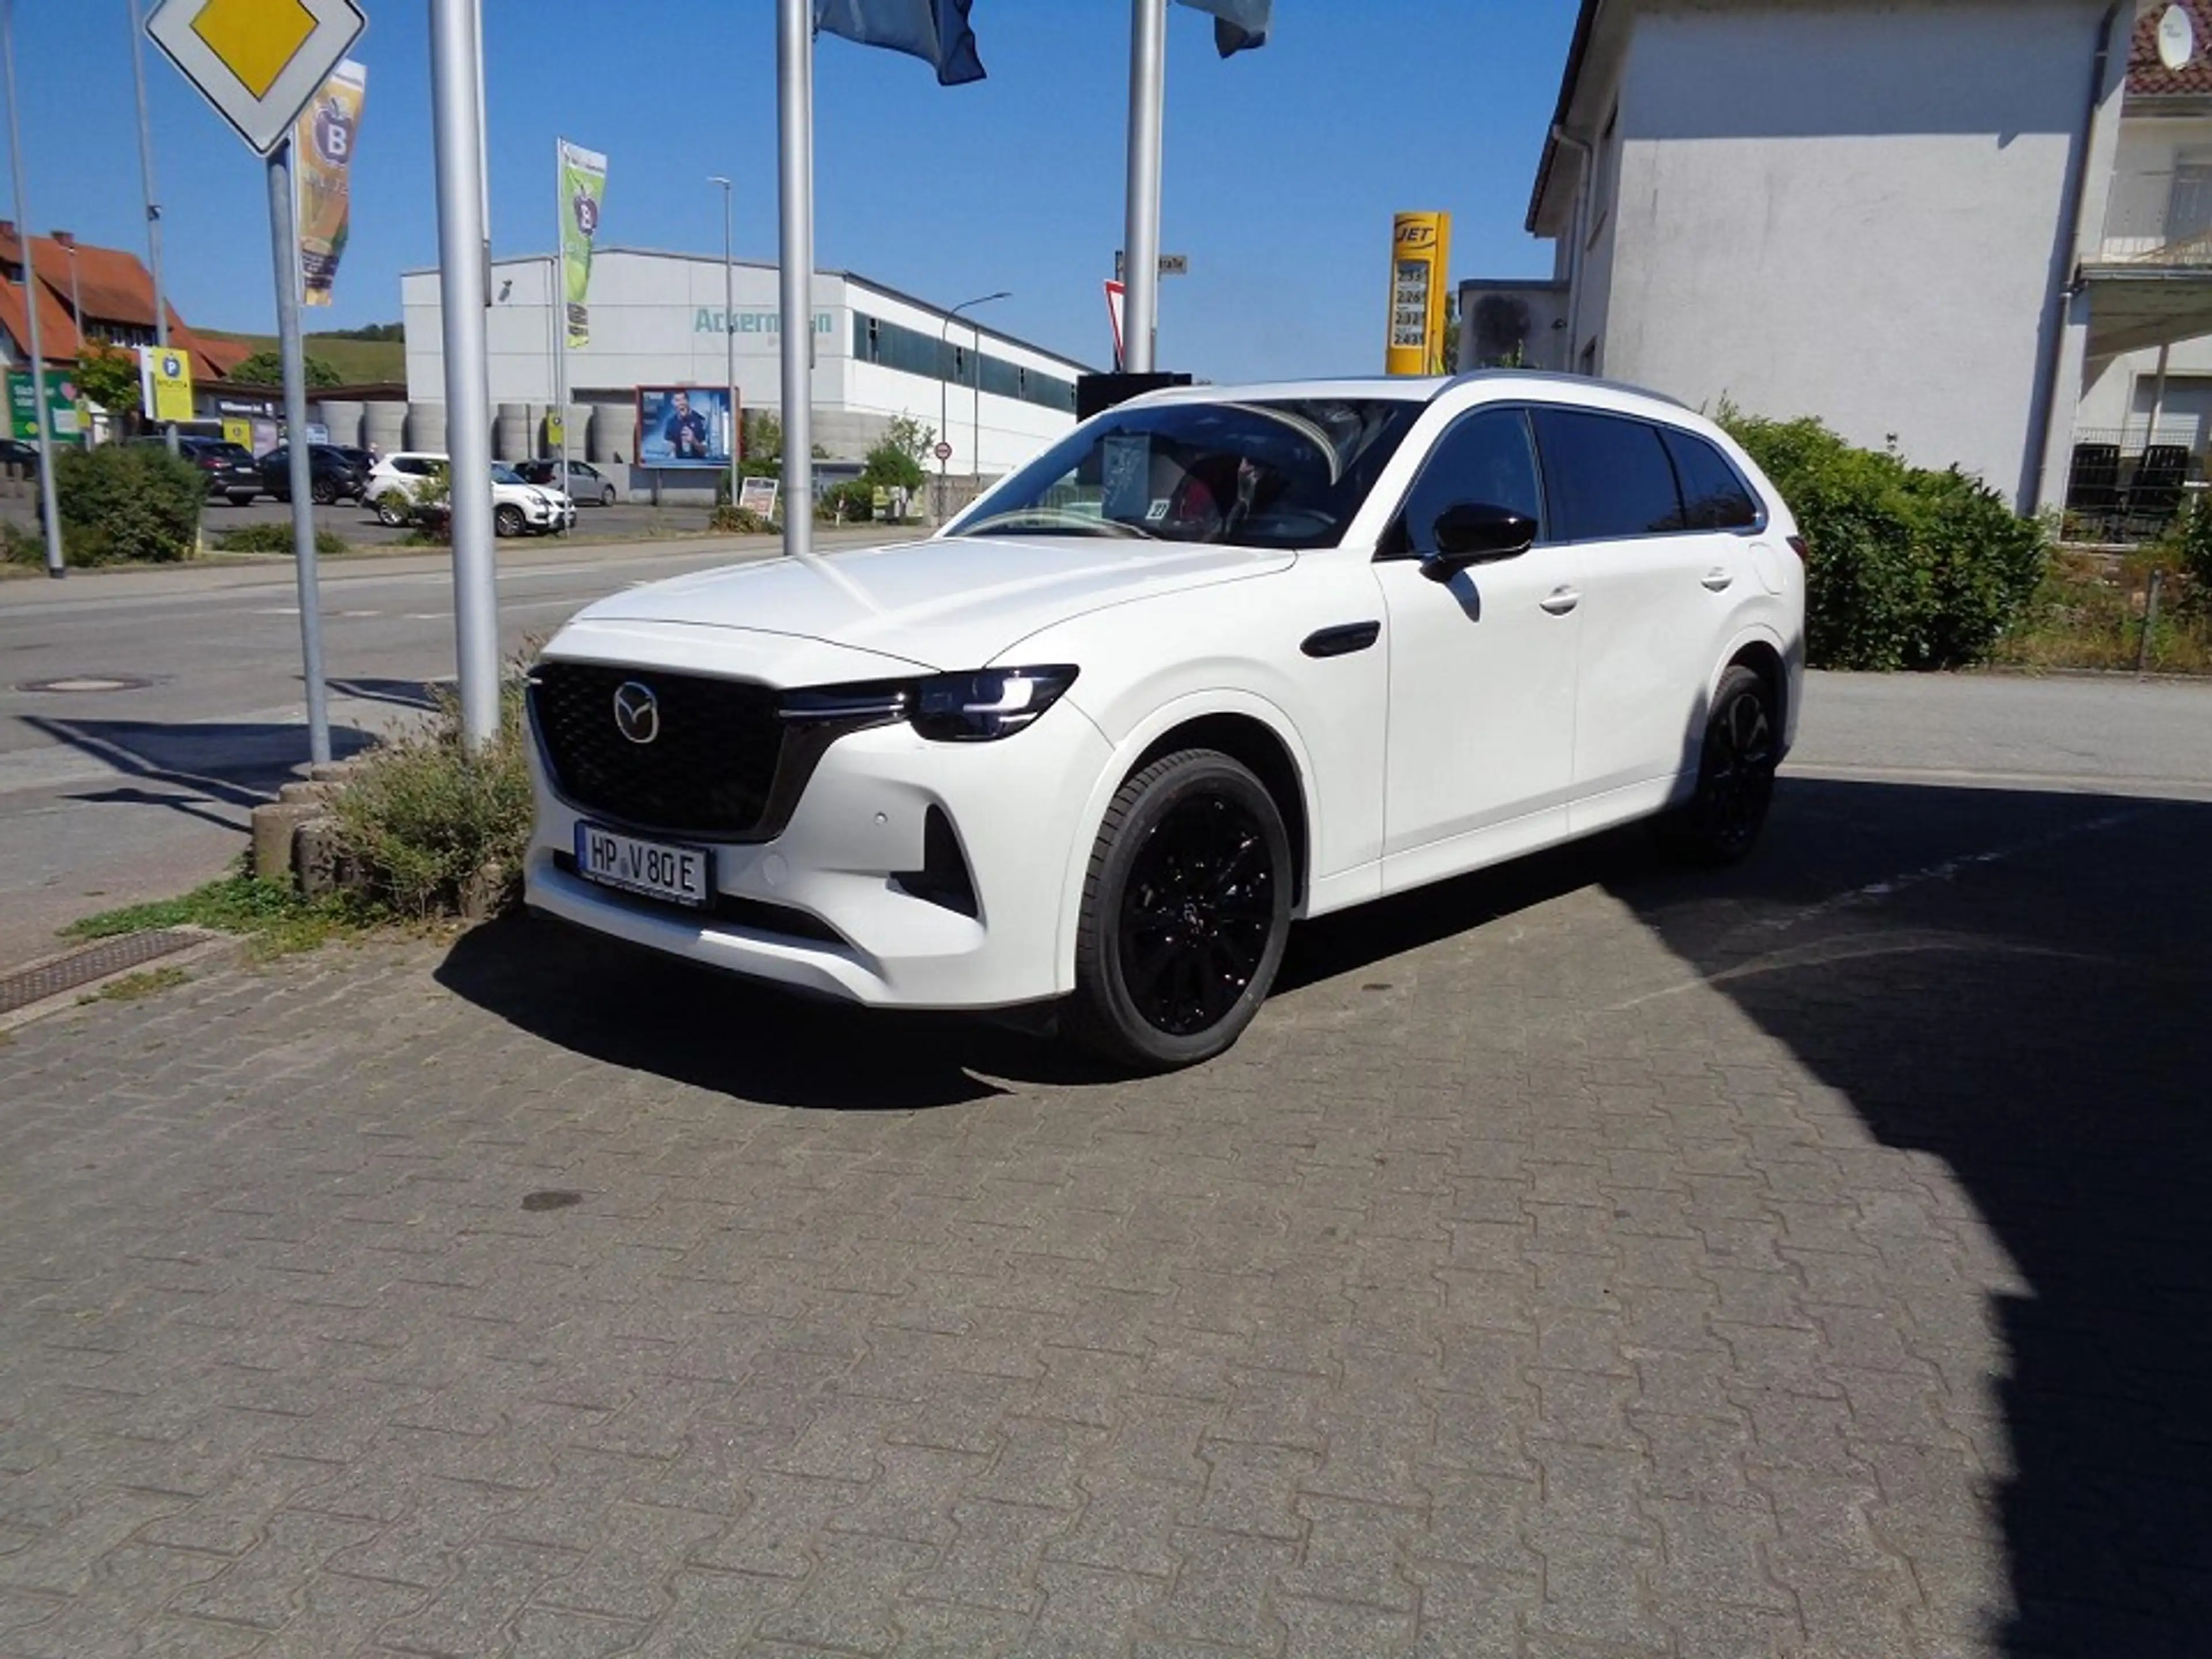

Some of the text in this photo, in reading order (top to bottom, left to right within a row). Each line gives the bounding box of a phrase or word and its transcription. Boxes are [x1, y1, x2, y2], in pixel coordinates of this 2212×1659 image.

[328, 123, 346, 156] B
[581, 205, 591, 229] B
[1396, 227, 1434, 241] JET
[694, 309, 832, 333] Ackermn
[592, 834, 617, 872] HP
